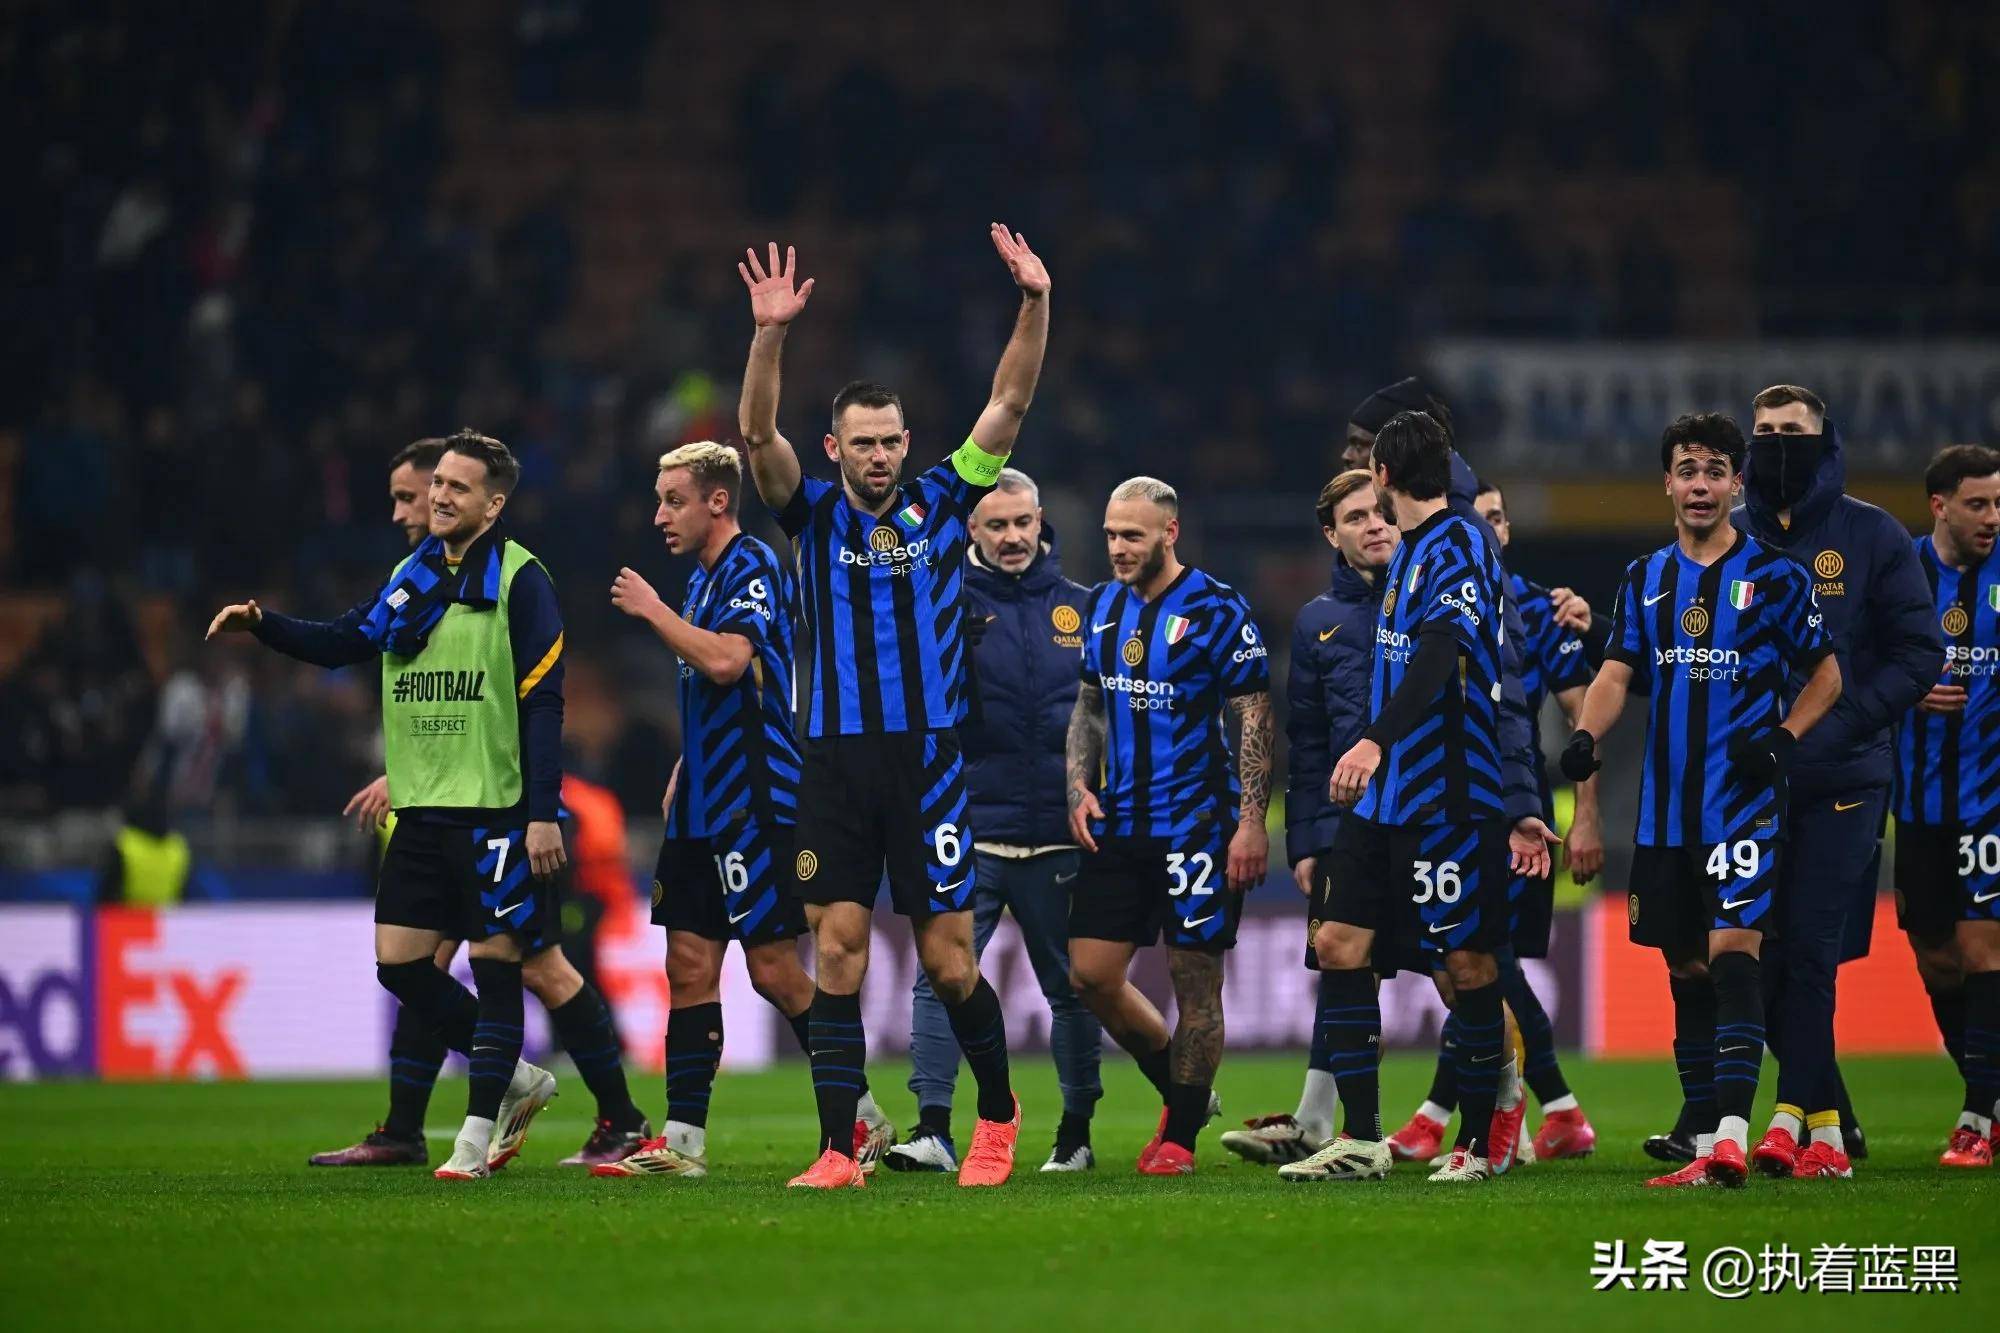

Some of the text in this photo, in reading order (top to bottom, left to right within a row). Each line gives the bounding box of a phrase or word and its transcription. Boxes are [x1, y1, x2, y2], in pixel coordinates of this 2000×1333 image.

[839, 538, 929, 566] betsson
[1440, 593, 1480, 626] Gate.io
[1376, 624, 1411, 648] tsson
[1655, 645, 1740, 666] betsson
[1945, 645, 1999, 662] sson
[392, 670, 486, 703] #FOOTBALL
[421, 719, 467, 731] RESPECT
[487, 837, 511, 883] 7
[934, 822, 961, 867] 6
[1706, 839, 1759, 881] 49
[1958, 834, 2000, 877] 30
[713, 851, 749, 895] 16
[1166, 852, 1214, 896] 32
[1412, 860, 1462, 904] 36
[0, 904, 248, 1080] dEx
